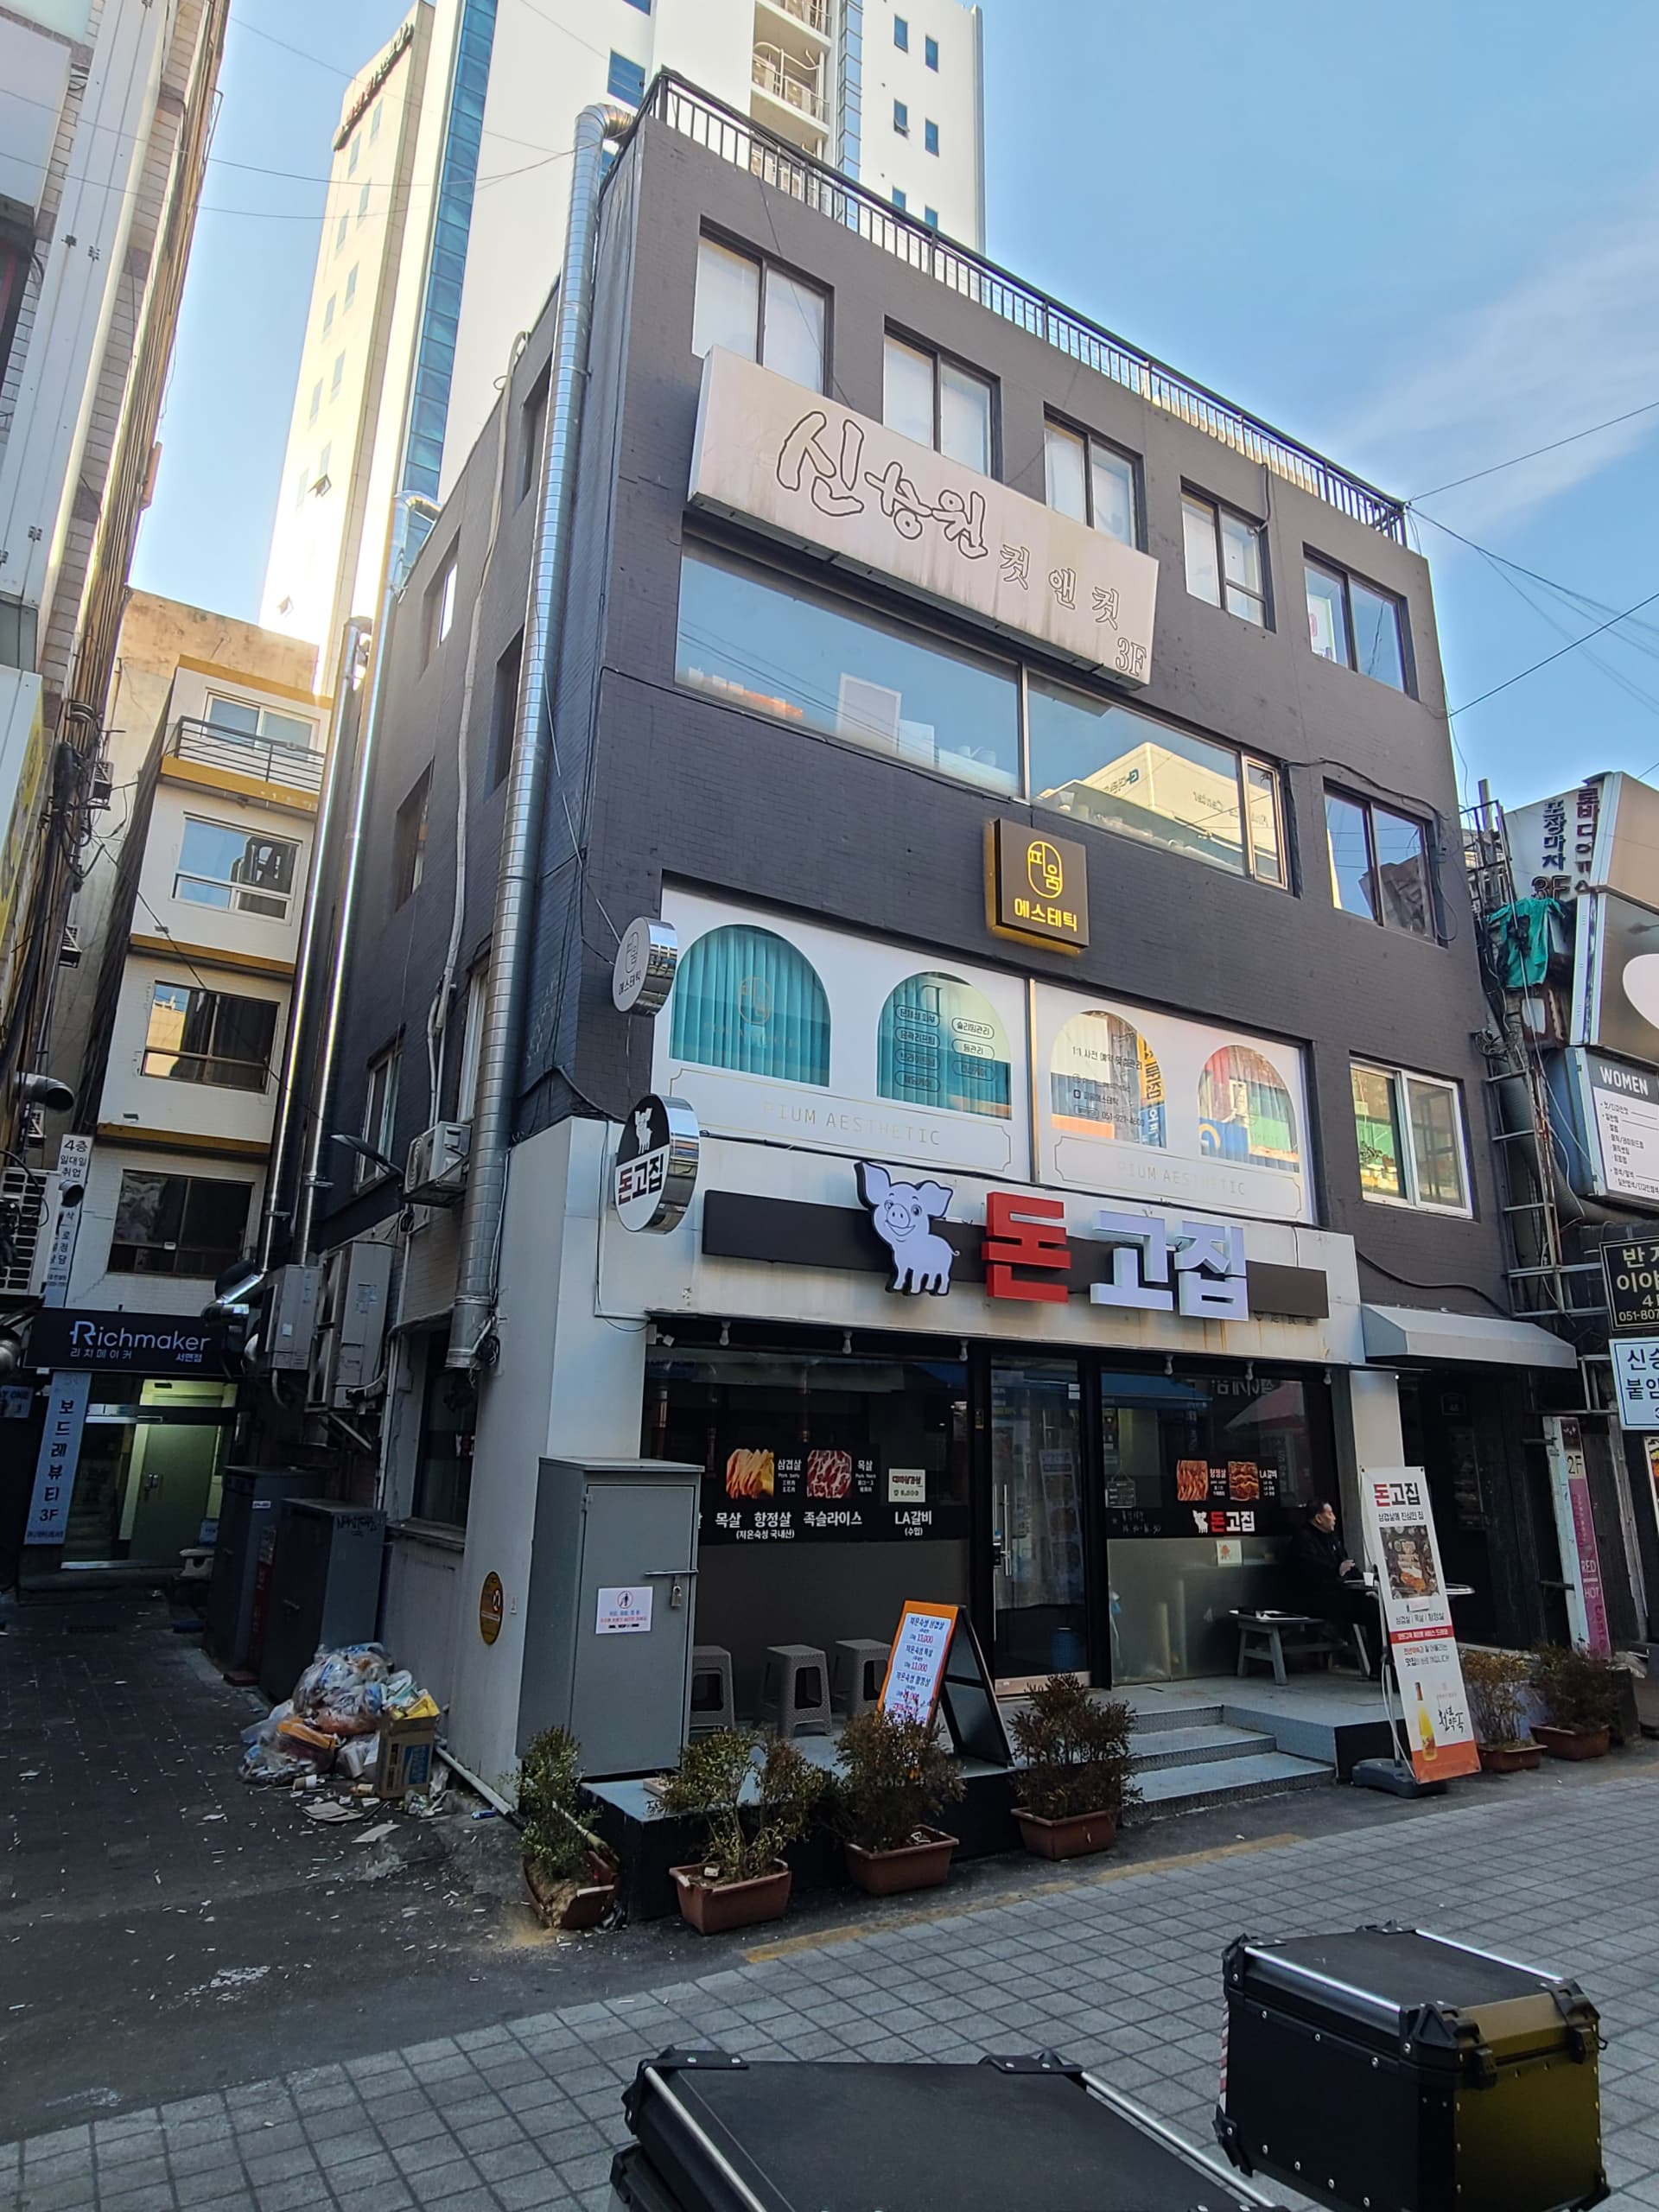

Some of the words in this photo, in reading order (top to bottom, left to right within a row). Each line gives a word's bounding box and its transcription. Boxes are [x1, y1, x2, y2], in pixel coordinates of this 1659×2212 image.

[1000, 543, 1031, 591] 컷
[1090, 586, 1120, 631] 컷
[1115, 636, 1147, 677] 3F
[1013, 896, 1079, 933] 에스테틱
[1599, 1065, 1649, 1096] WOMEN
[761, 1099, 817, 1125] PIUM
[825, 1112, 941, 1146] AESTHETIC
[63, 1139, 88, 1154] 4층
[60, 1154, 86, 1166] 일대일
[61, 1167, 82, 1179] 취업
[618, 1153, 664, 1206] 돈고집
[982, 1192, 1249, 1322] 돈고집
[69, 1320, 212, 1351] Richmaker
[777, 1458, 803, 1472] 삼겹살
[857, 1459, 874, 1471] 목살
[1567, 1455, 1583, 1476] 2F
[1373, 1482, 1421, 1508] 돈고집
[39, 1508, 59, 1522] 3F
[715, 1512, 742, 1529] 목살
[754, 1511, 792, 1529] 항정살
[804, 1510, 863, 1527] 족슬라이스
[894, 1510, 933, 1526] LA갈비
[1210, 1510, 1255, 1533] 돈고집
[1580, 1559, 1597, 1574] RED
